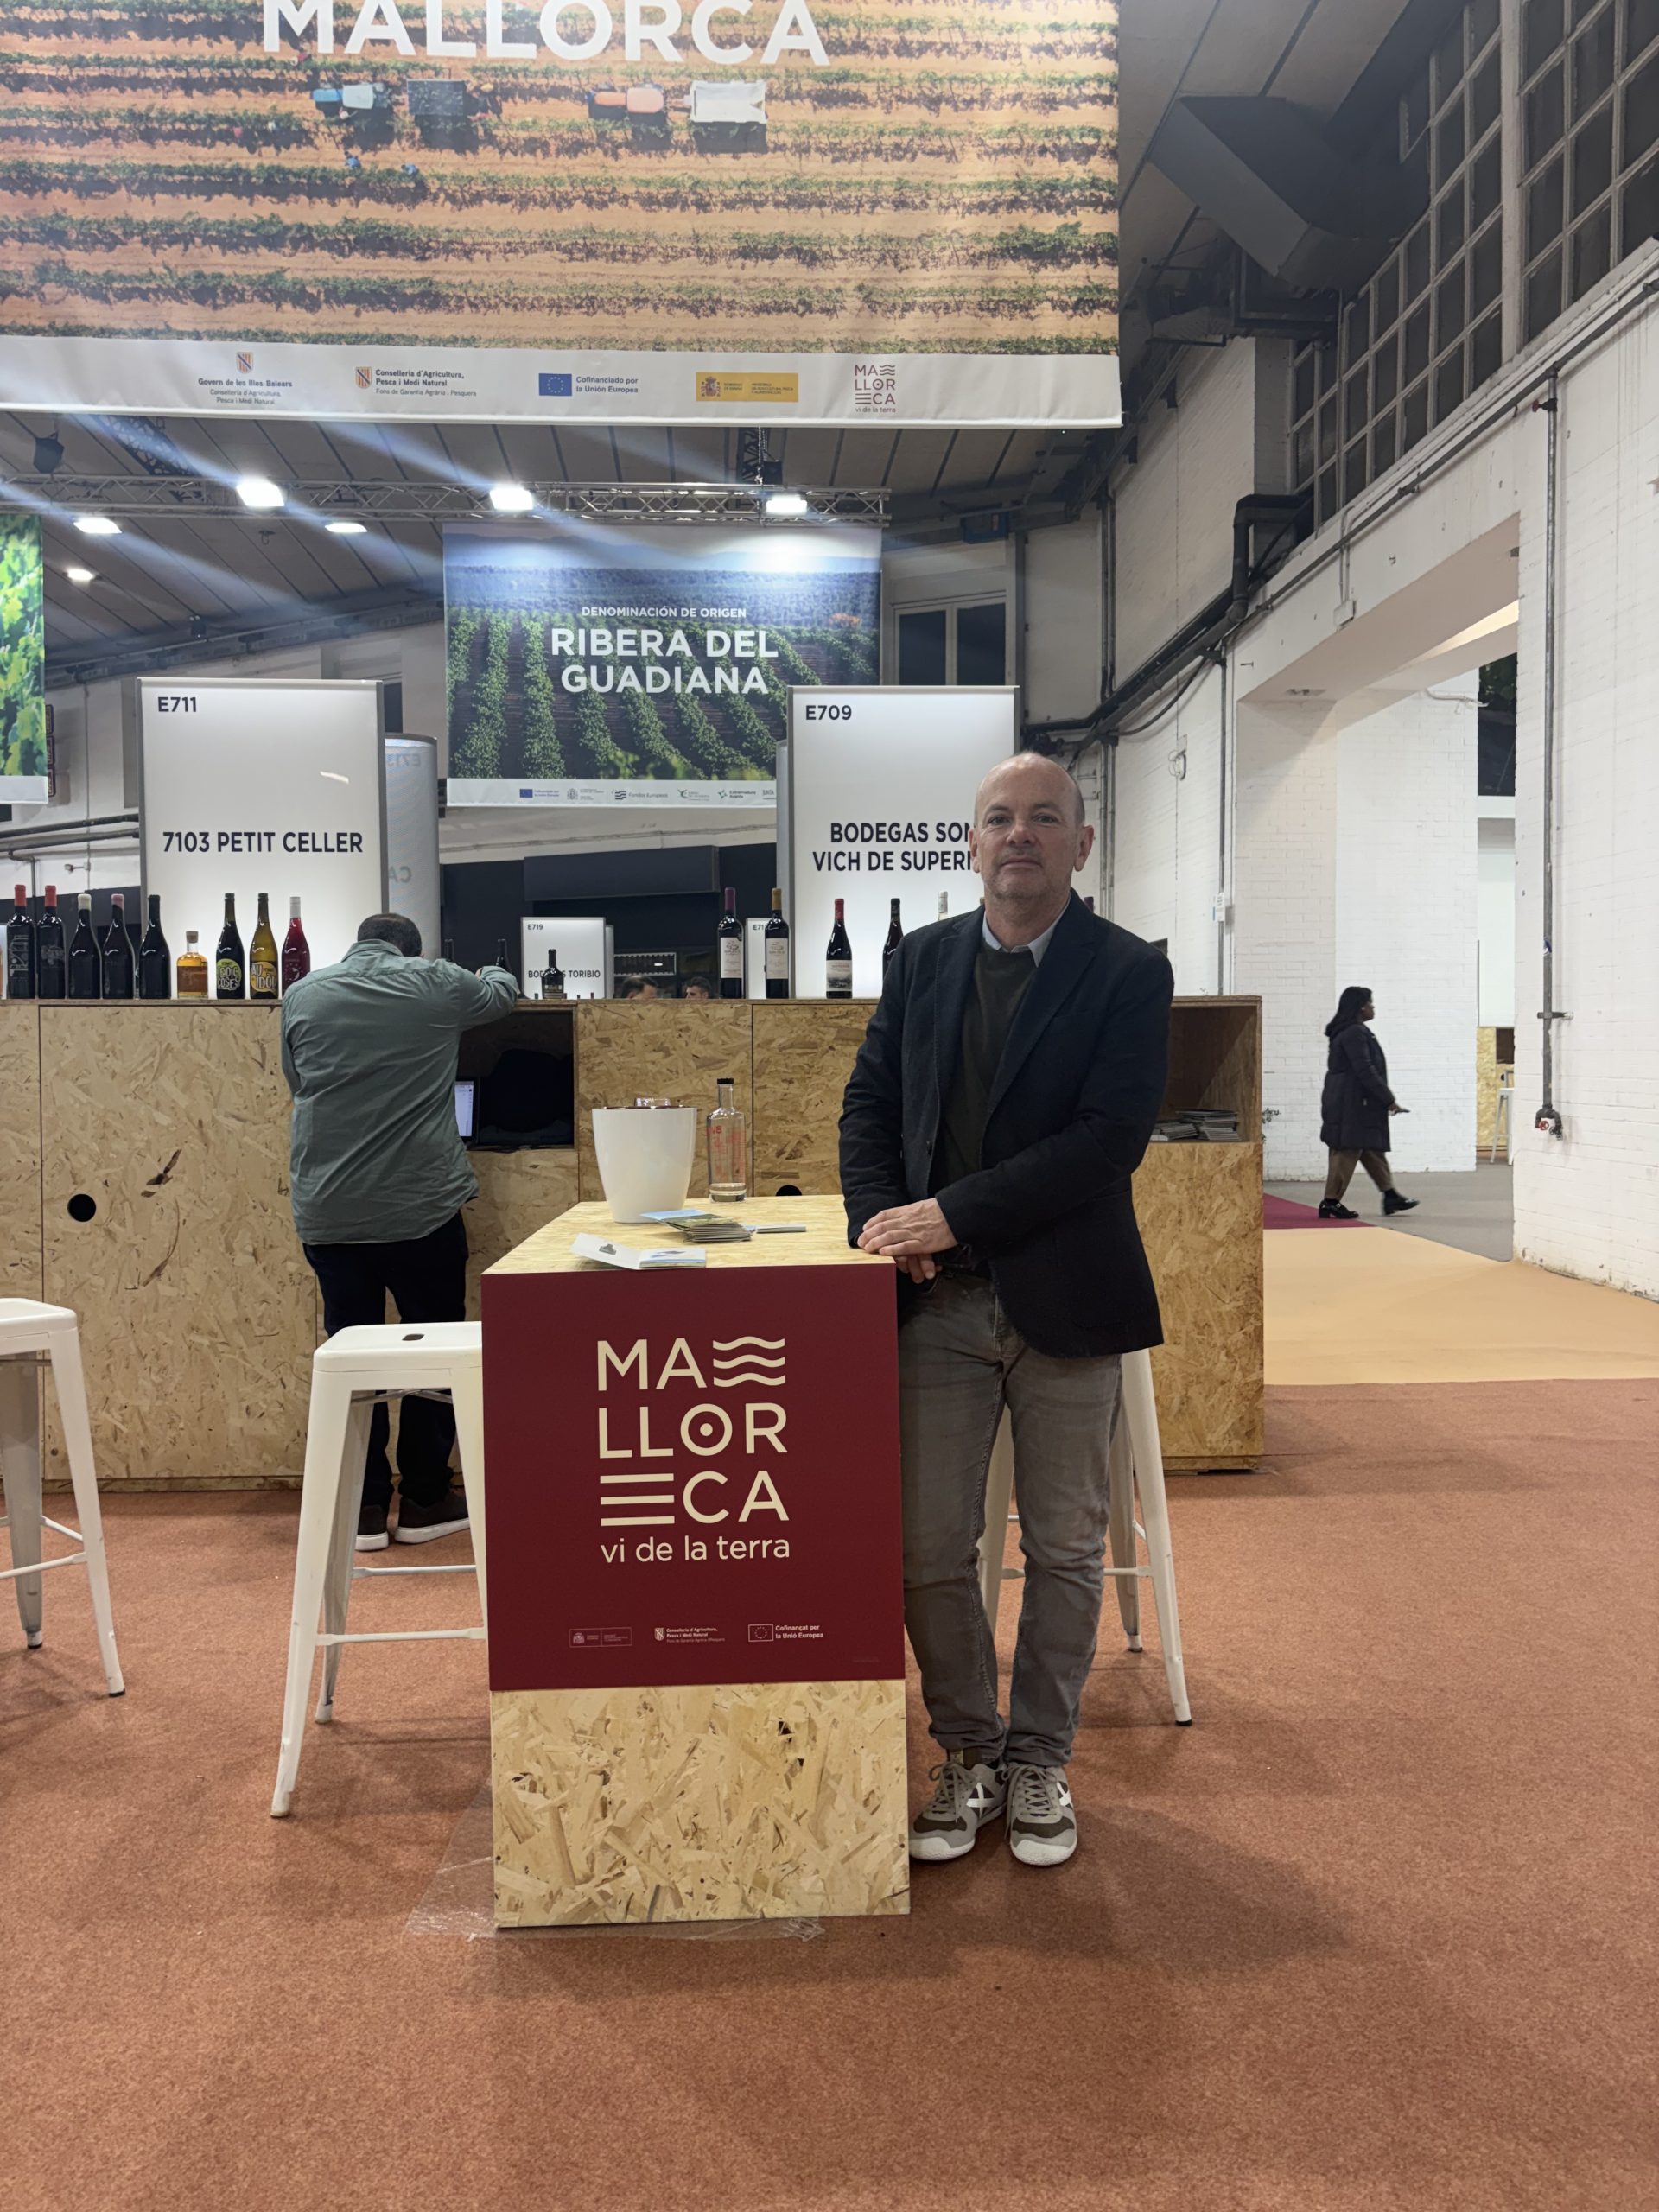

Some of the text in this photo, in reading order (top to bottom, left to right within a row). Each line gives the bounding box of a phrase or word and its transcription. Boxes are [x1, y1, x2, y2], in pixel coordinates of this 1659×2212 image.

[264, 0, 831, 66] MALLORCA
[198, 378, 223, 386] Govern
[607, 385, 639, 394] Europea
[582, 606, 747, 618] DENOMINACIÓN DE ORIGEN
[551, 628, 779, 658] RIBERA DEL
[561, 664, 768, 694] GUADIANA
[157, 696, 197, 712] E711
[805, 705, 852, 721] E709
[162, 831, 364, 853] 7103 PETIT CELLER
[830, 822, 929, 843] BODEGAS
[812, 850, 971, 872] VICH DE SUPER
[568, 969, 601, 978] TORIBIO
[601, 1535, 790, 1563] vi de la terra
